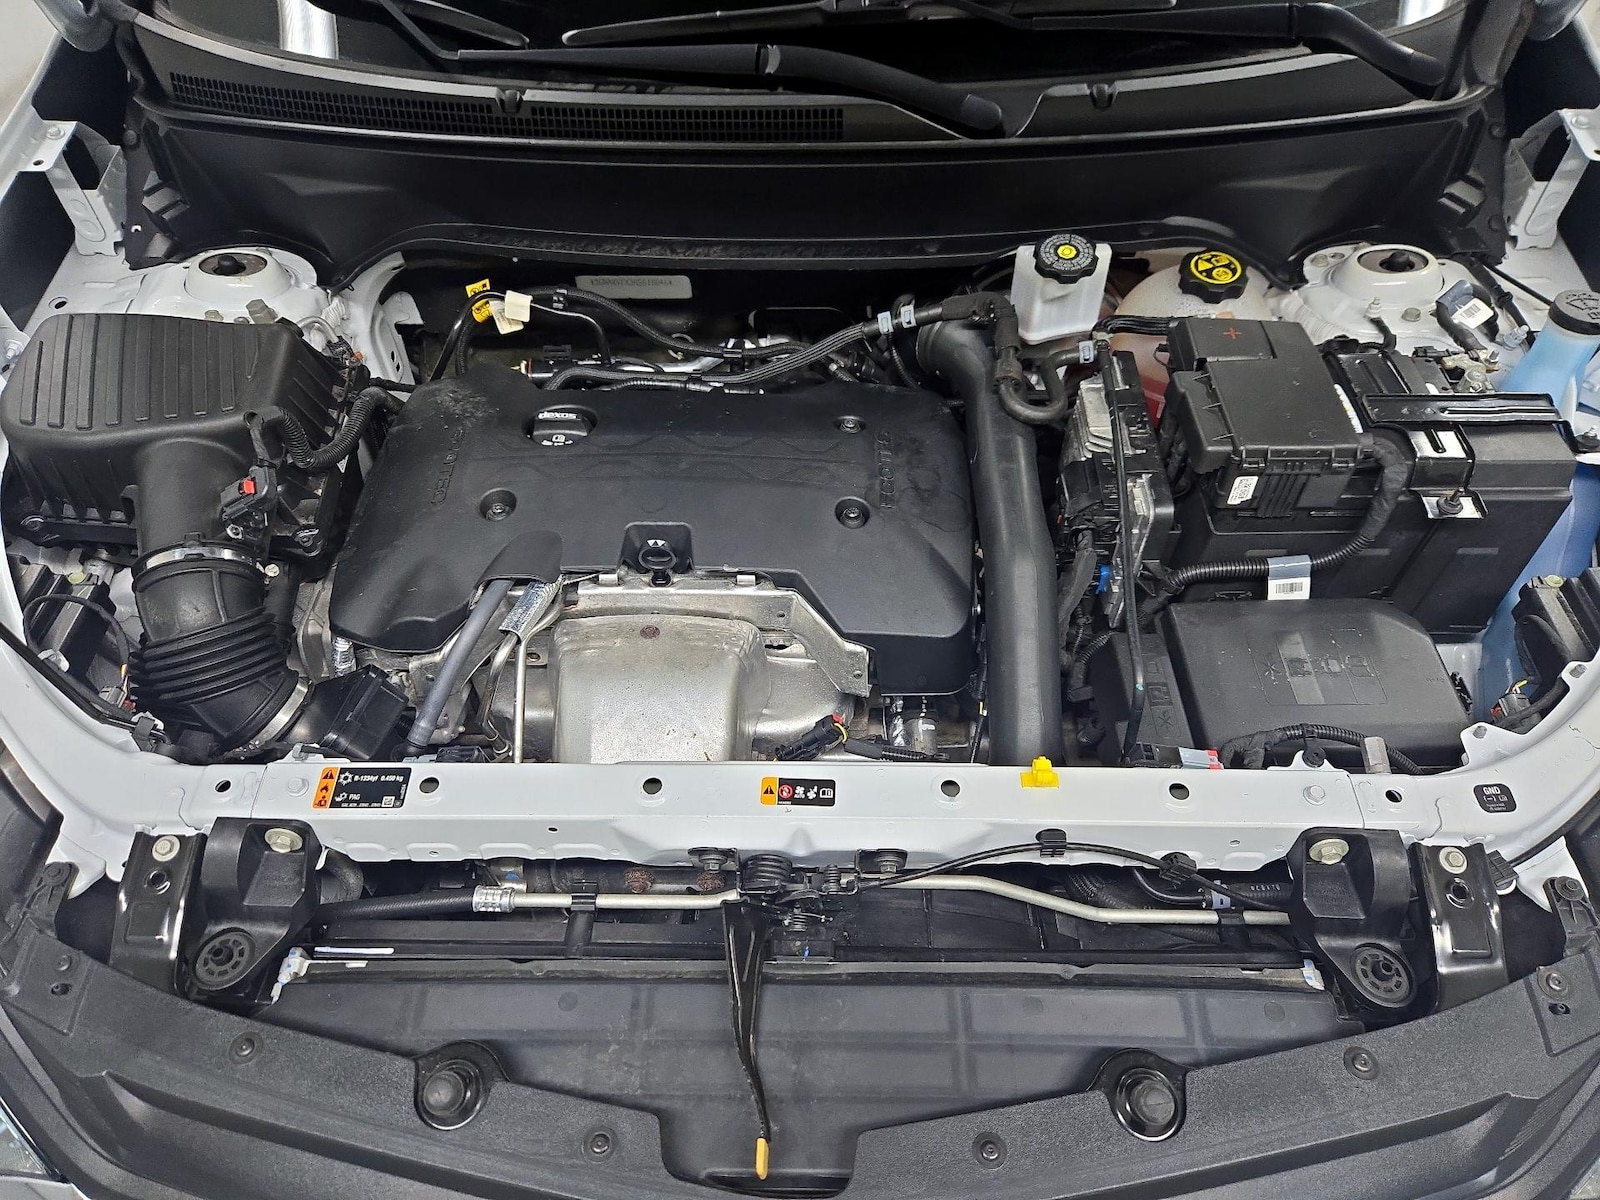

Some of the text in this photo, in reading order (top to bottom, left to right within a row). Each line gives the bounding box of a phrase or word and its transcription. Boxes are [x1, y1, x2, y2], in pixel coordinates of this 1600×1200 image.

[538, 411, 577, 419] dexos
[876, 430, 896, 508] ECOTEC
[1483, 786, 1501, 795] GND
